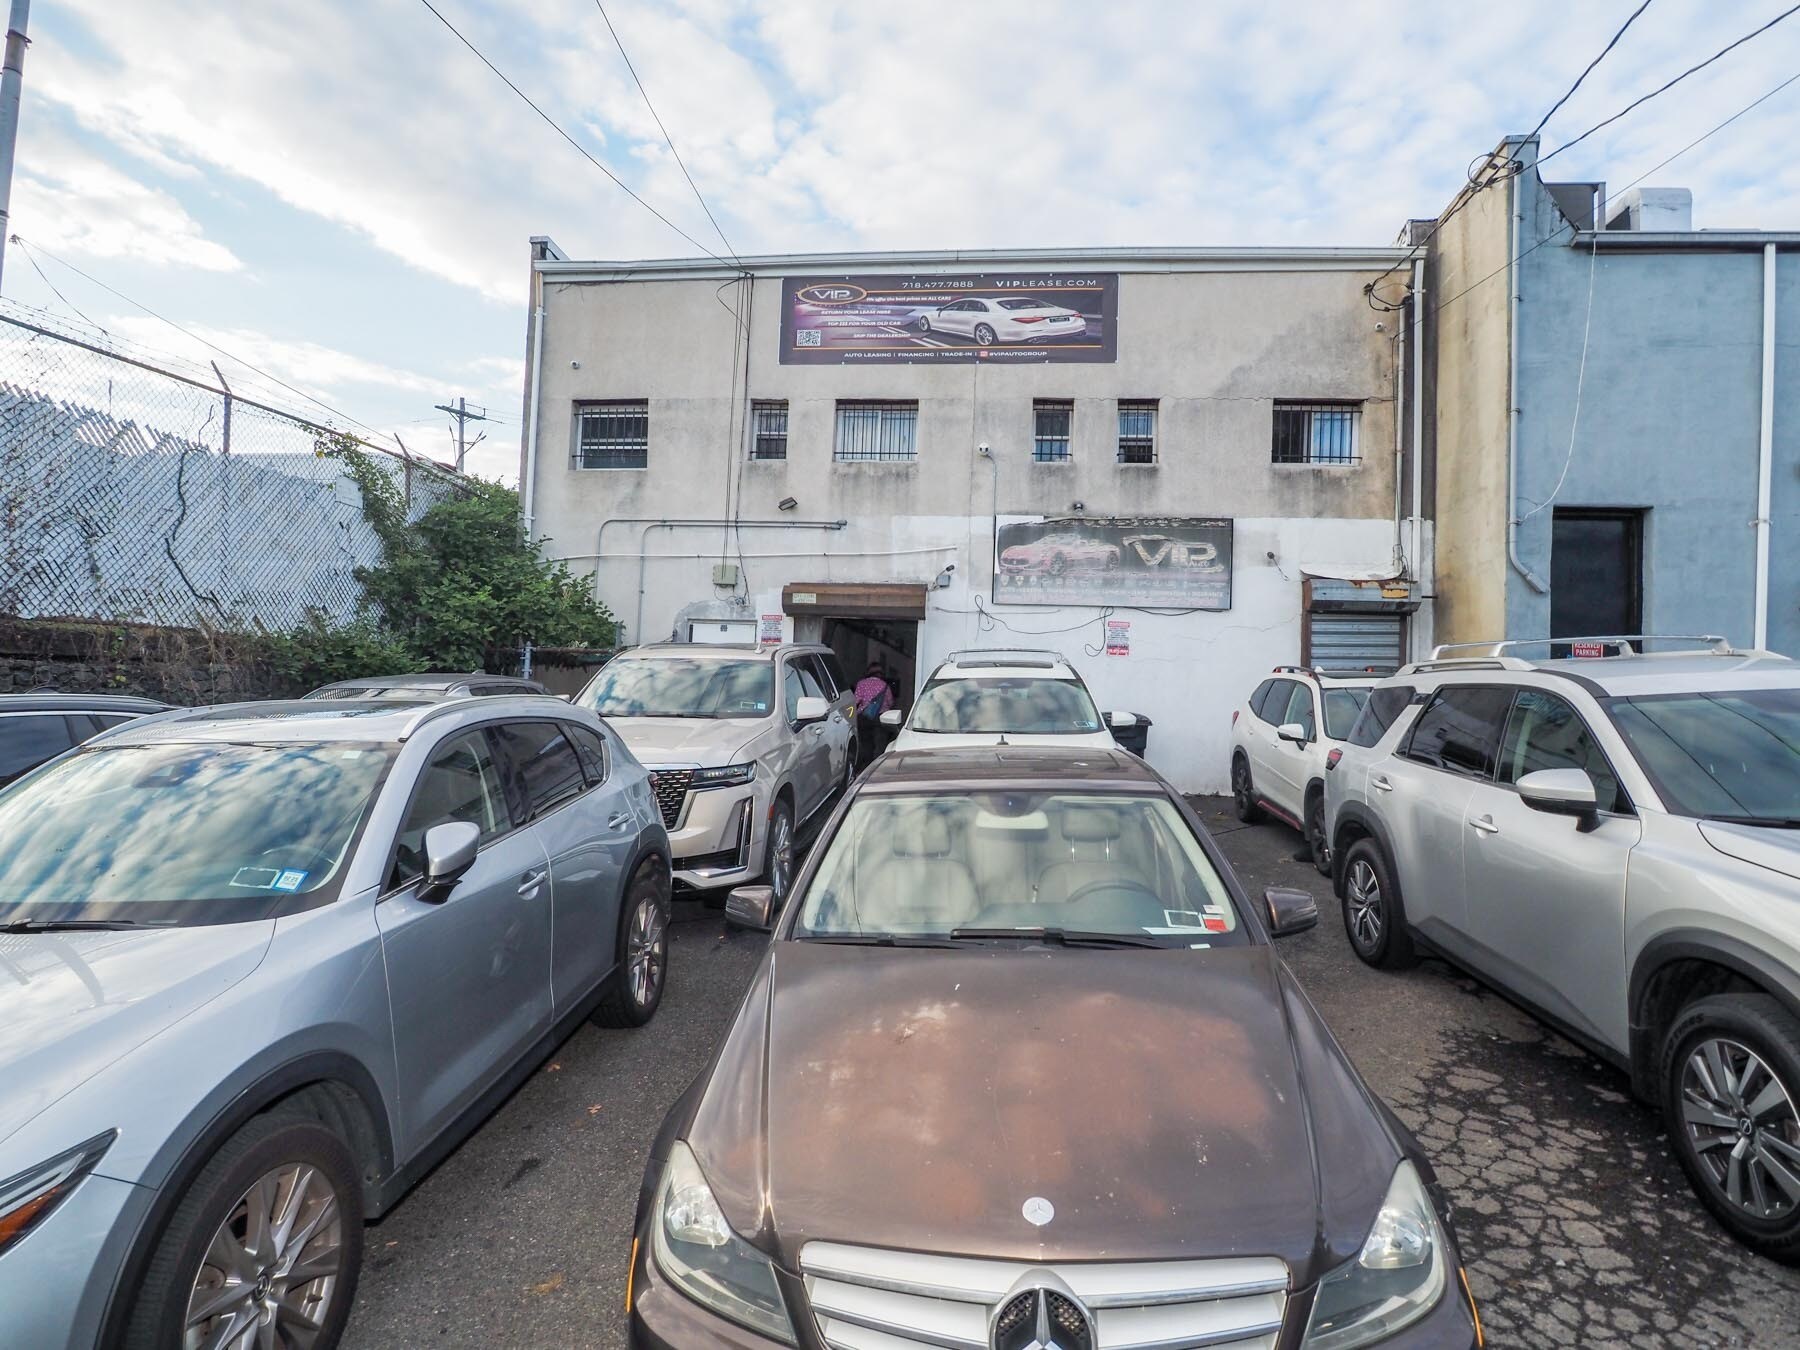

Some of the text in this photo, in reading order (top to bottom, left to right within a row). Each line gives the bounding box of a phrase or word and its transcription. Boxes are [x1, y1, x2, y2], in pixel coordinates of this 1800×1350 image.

[902, 280, 974, 289] 718.477.7888
[995, 279, 1097, 288] VIPLEASE.COM
[811, 288, 853, 300] VIP
[1123, 534, 1218, 566] VIP
[1575, 648, 1599, 656] PARKING
